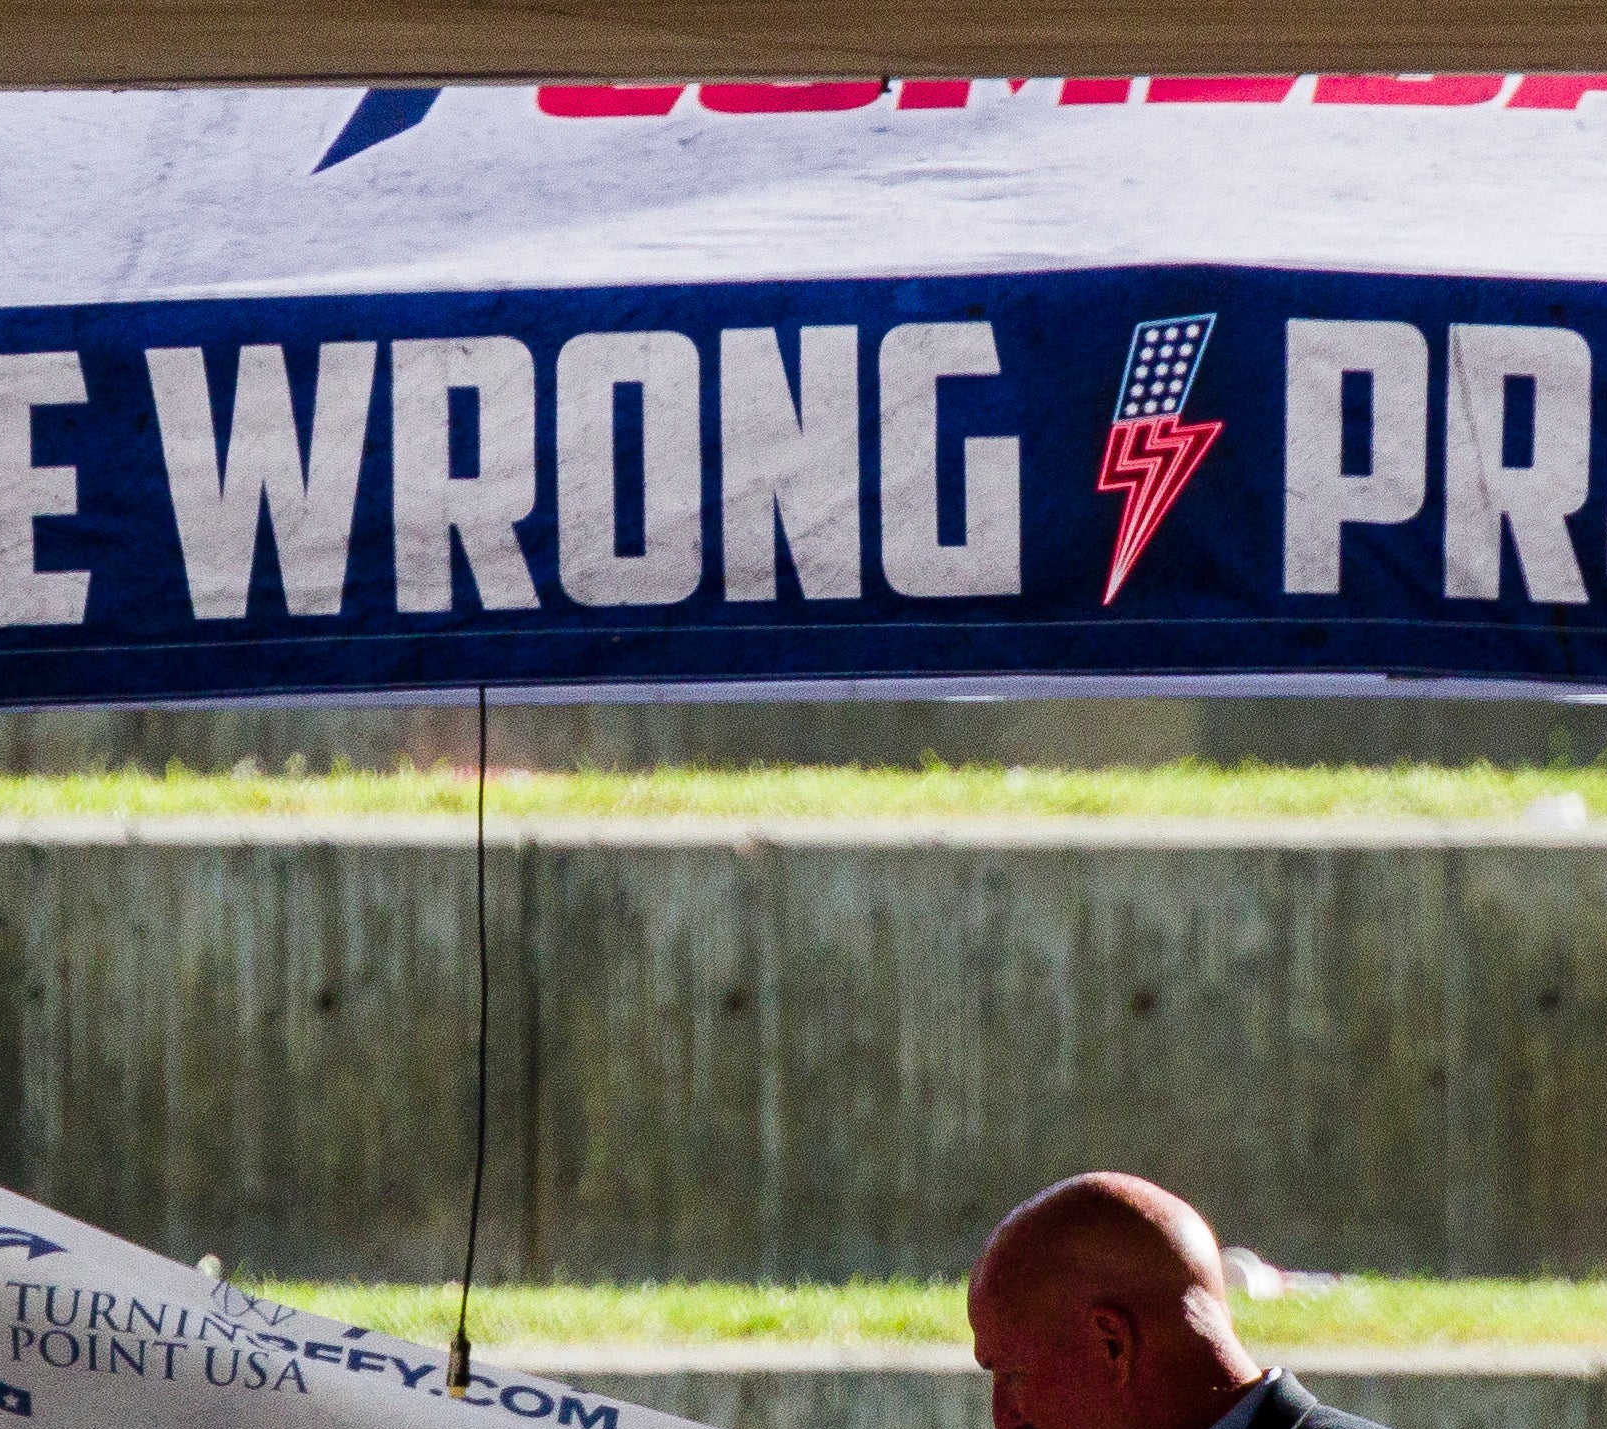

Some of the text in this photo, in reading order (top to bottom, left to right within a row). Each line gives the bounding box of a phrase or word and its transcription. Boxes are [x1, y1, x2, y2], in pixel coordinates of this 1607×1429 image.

[143, 319, 1022, 621] WRONG
[6, 1280, 242, 1341] TURNIN
[9, 1323, 308, 1395] POINT USA
